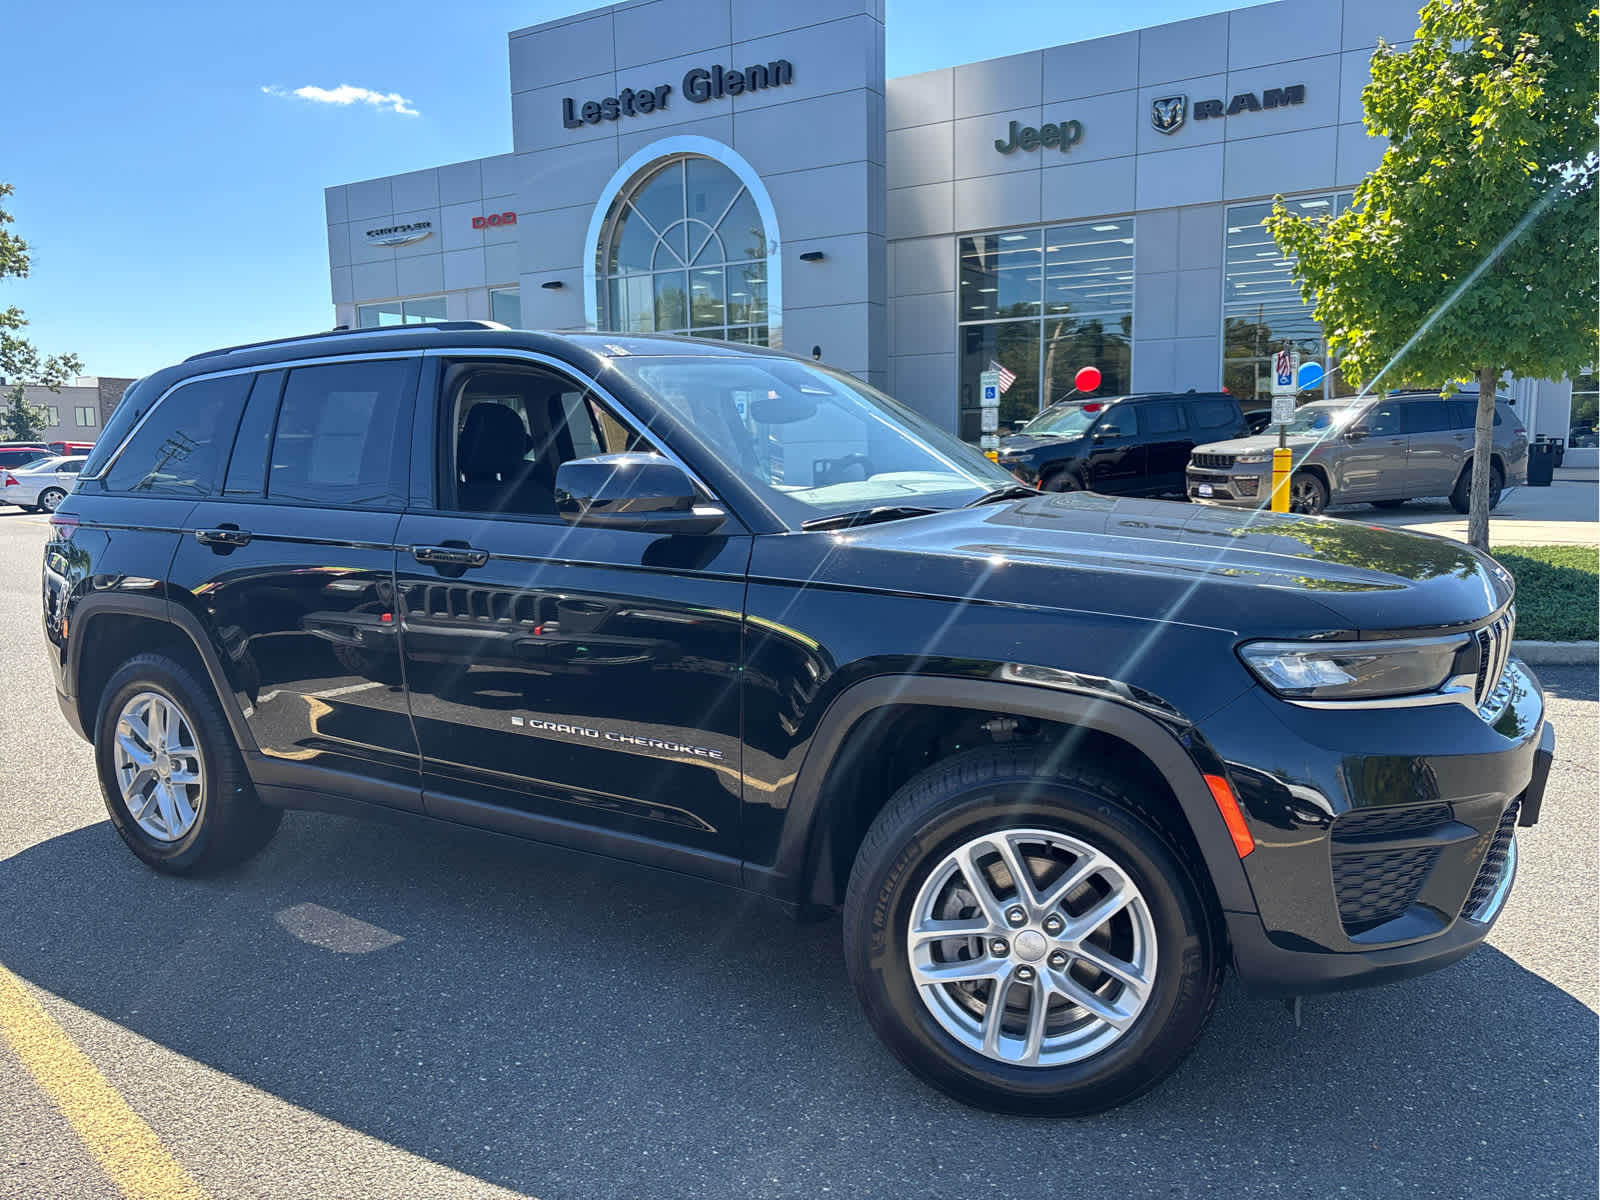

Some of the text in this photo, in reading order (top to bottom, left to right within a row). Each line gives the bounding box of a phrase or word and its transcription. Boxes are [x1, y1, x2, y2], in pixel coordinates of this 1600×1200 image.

[562, 58, 794, 129] Lester Glenn
[1193, 84, 1305, 121] RAM
[994, 119, 1083, 153] Jeep
[366, 221, 432, 238] CHRYSLER
[529, 718, 726, 760] GRAND CHEROKEE
[871, 842, 921, 929] MICHELIN
